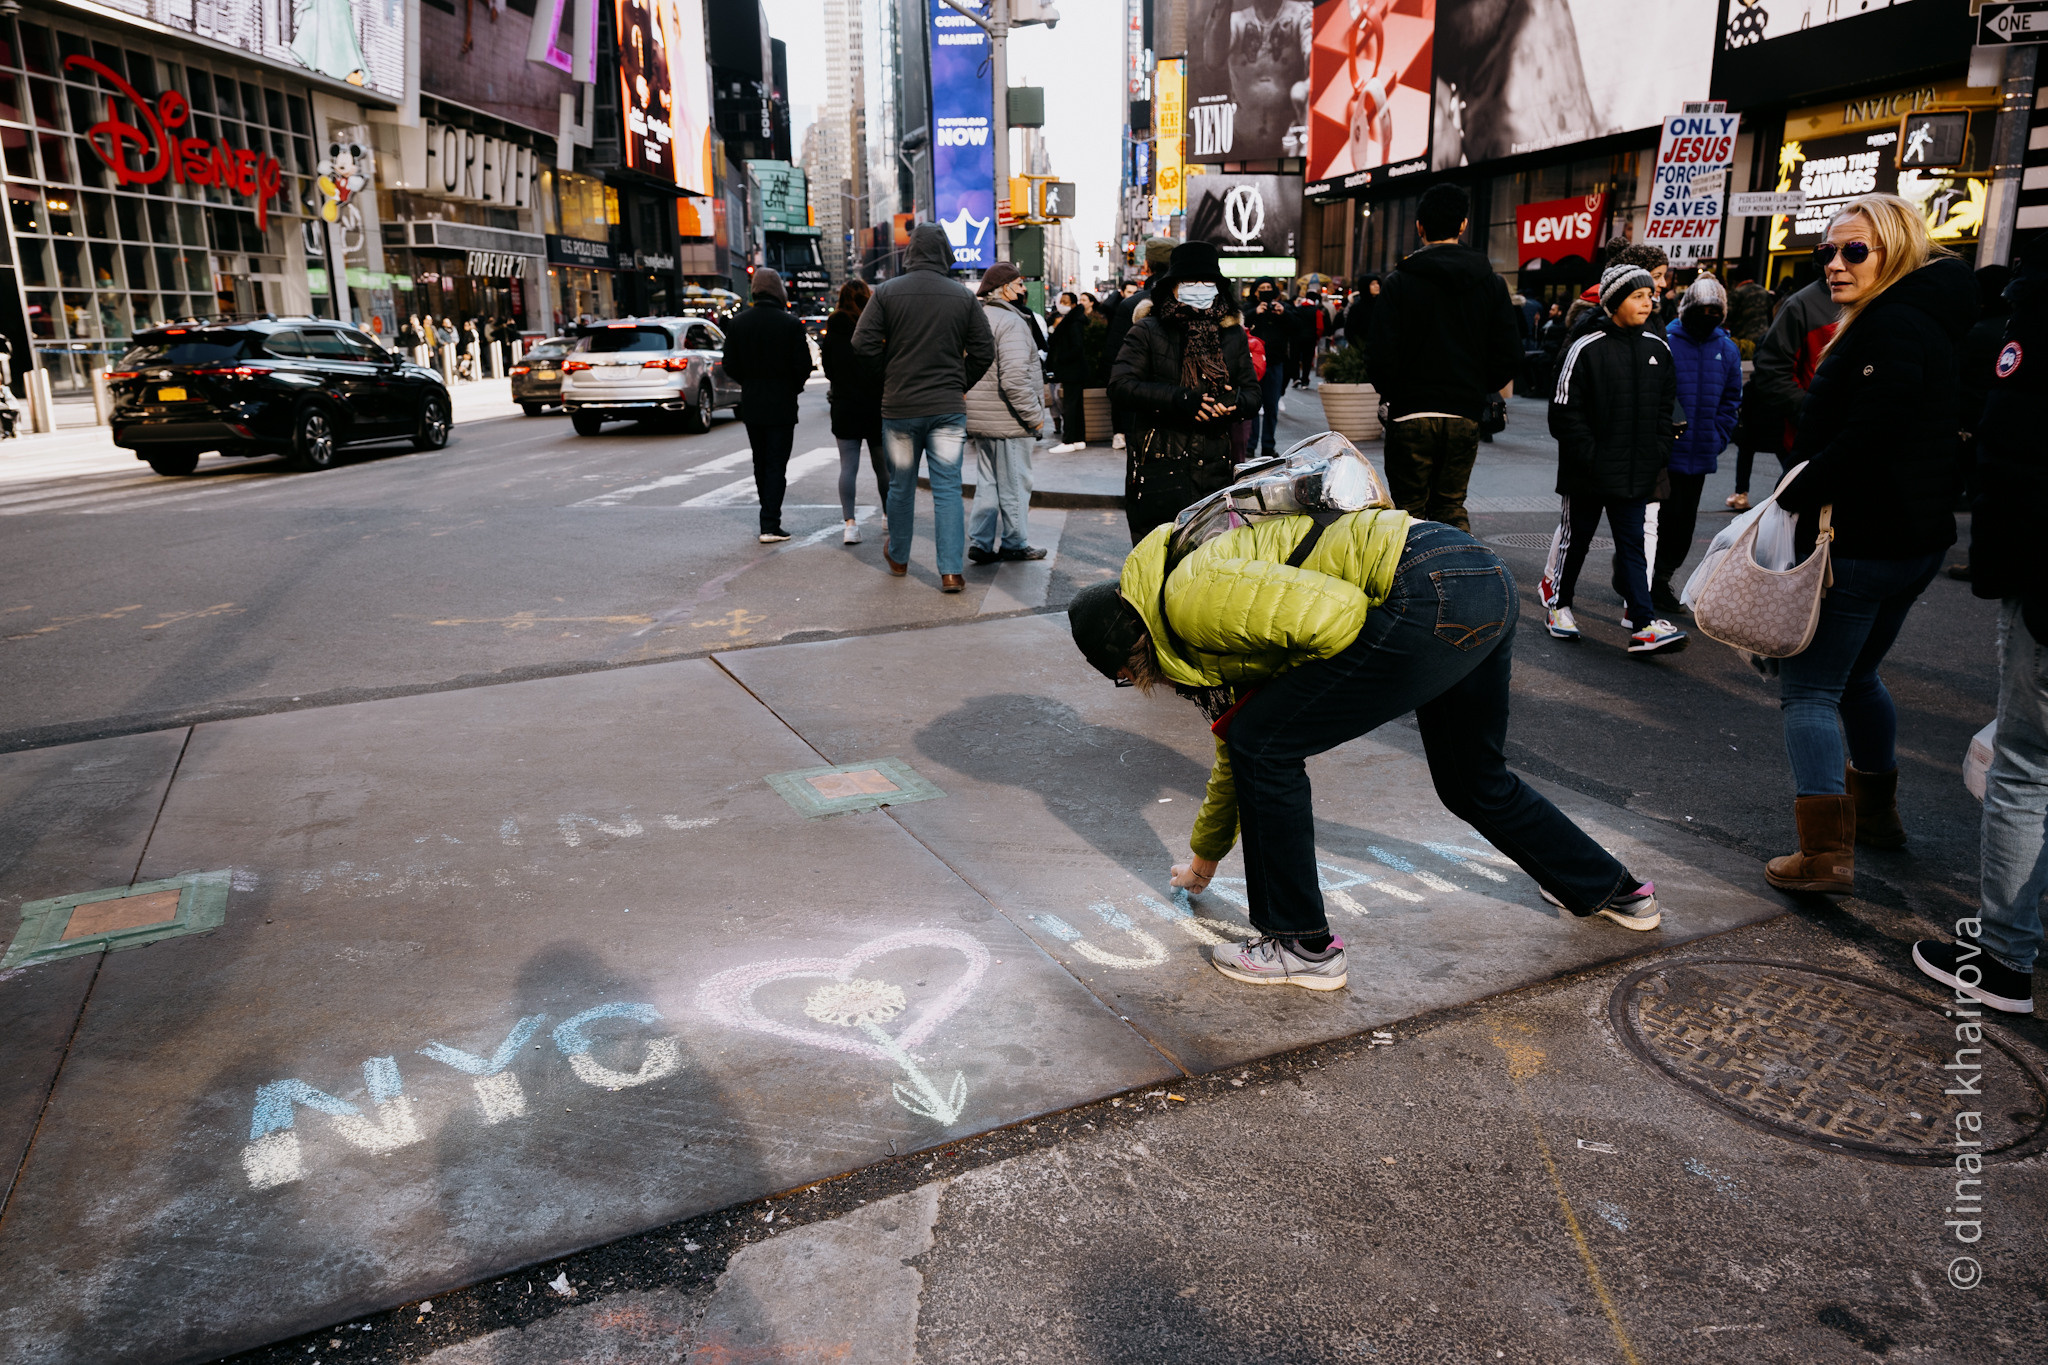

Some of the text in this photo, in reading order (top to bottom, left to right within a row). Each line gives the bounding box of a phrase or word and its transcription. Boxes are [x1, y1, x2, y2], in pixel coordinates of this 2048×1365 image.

[1998, 14, 2032, 32] ONE
[938, 33, 985, 45] MARKET
[1703, 103, 1710, 113] OF
[1713, 103, 1725, 113] GOD
[1842, 87, 1937, 125] INVICTA
[1670, 118, 1734, 136] ONLY
[937, 127, 989, 147] NOW
[1663, 136, 1731, 163] JESUS
[426, 117, 542, 211] FOREVER
[1801, 151, 1880, 177] SPRING TIME
[1800, 168, 1877, 199] SAVINGS
[1654, 201, 1718, 217] SAVES
[1646, 219, 1719, 238] REPENT
[1795, 218, 1831, 235] WATC
[1669, 244, 1714, 258] IS NEAR
[466, 251, 514, 278] FOREVER
[240, 1001, 682, 1191] NYC
